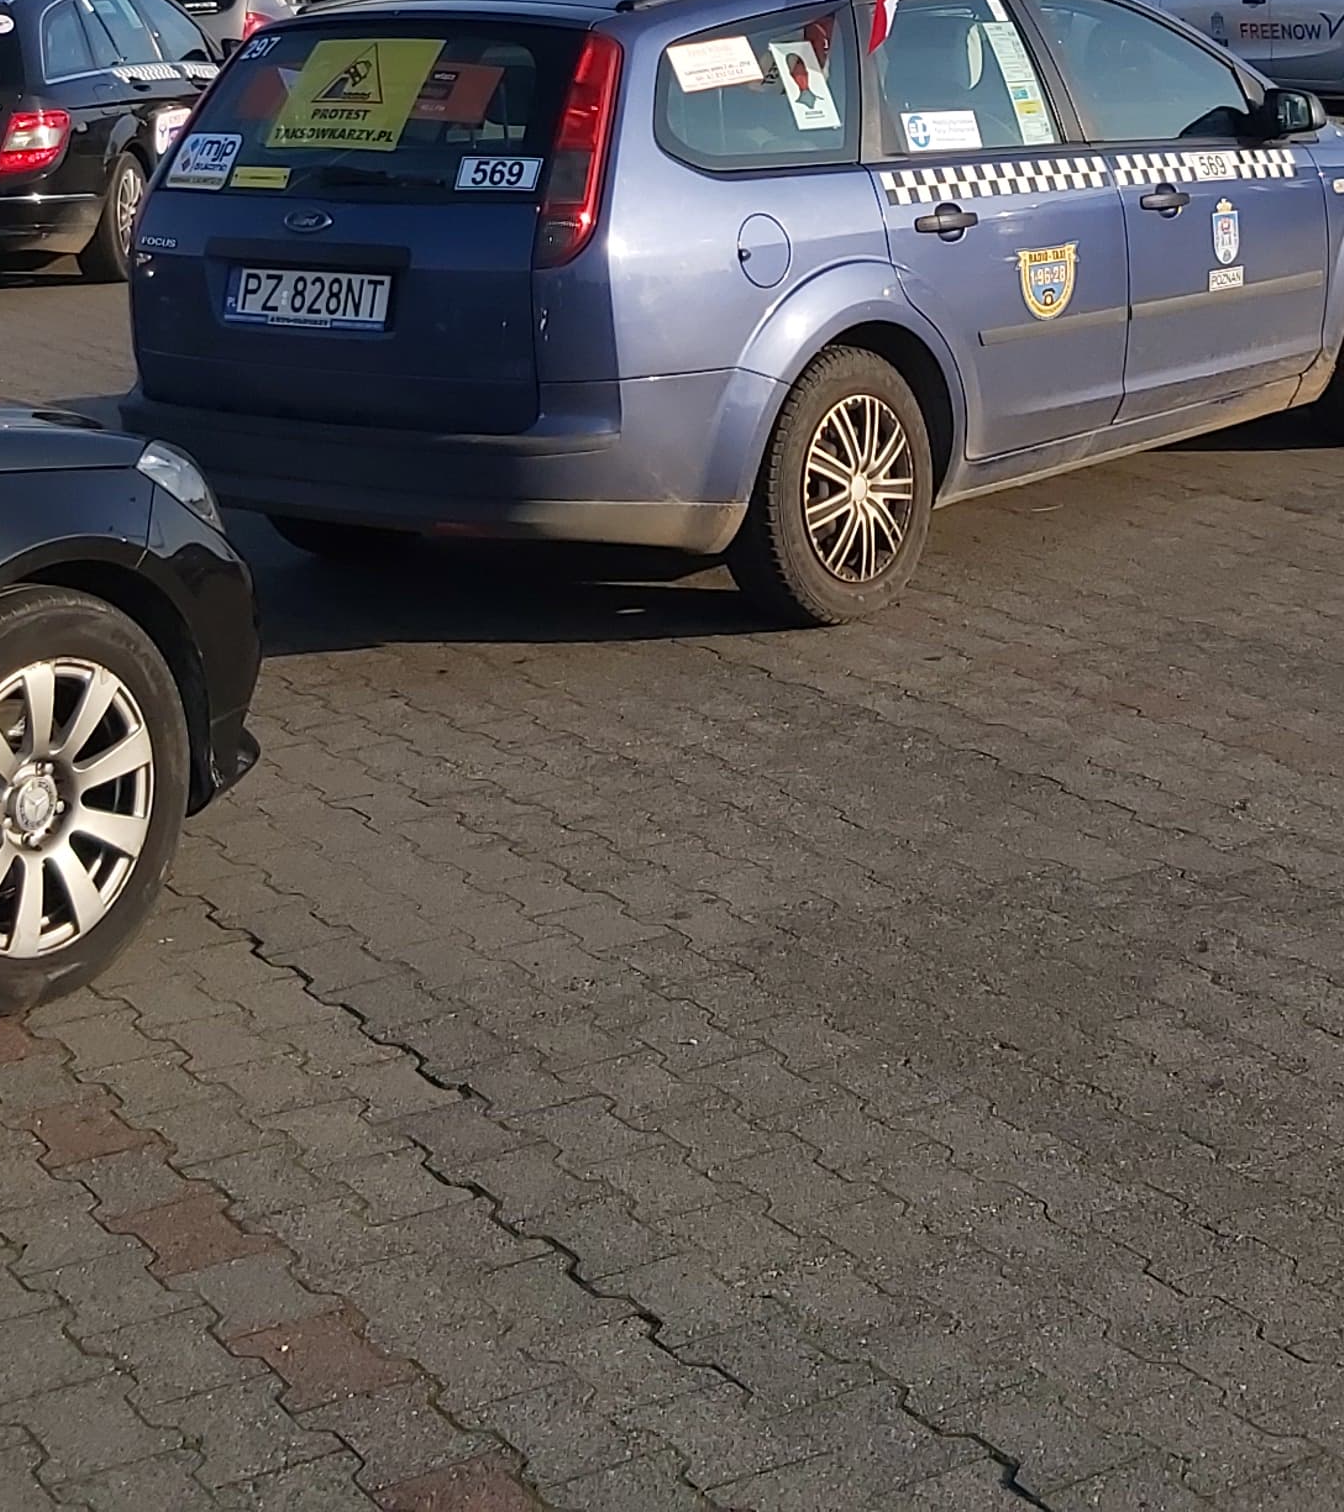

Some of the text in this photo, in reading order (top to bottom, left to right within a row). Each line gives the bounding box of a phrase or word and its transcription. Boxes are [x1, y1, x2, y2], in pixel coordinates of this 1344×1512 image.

[1240, 23, 1321, 41] FREENOW
[240, 37, 281, 60] 297
[311, 108, 371, 121] PROTEST
[199, 138, 237, 163] mjp
[471, 161, 525, 186] 569
[1198, 155, 1228, 177] 569
[141, 236, 177, 248] FOCUS
[241, 271, 386, 319] PZ 828NT
